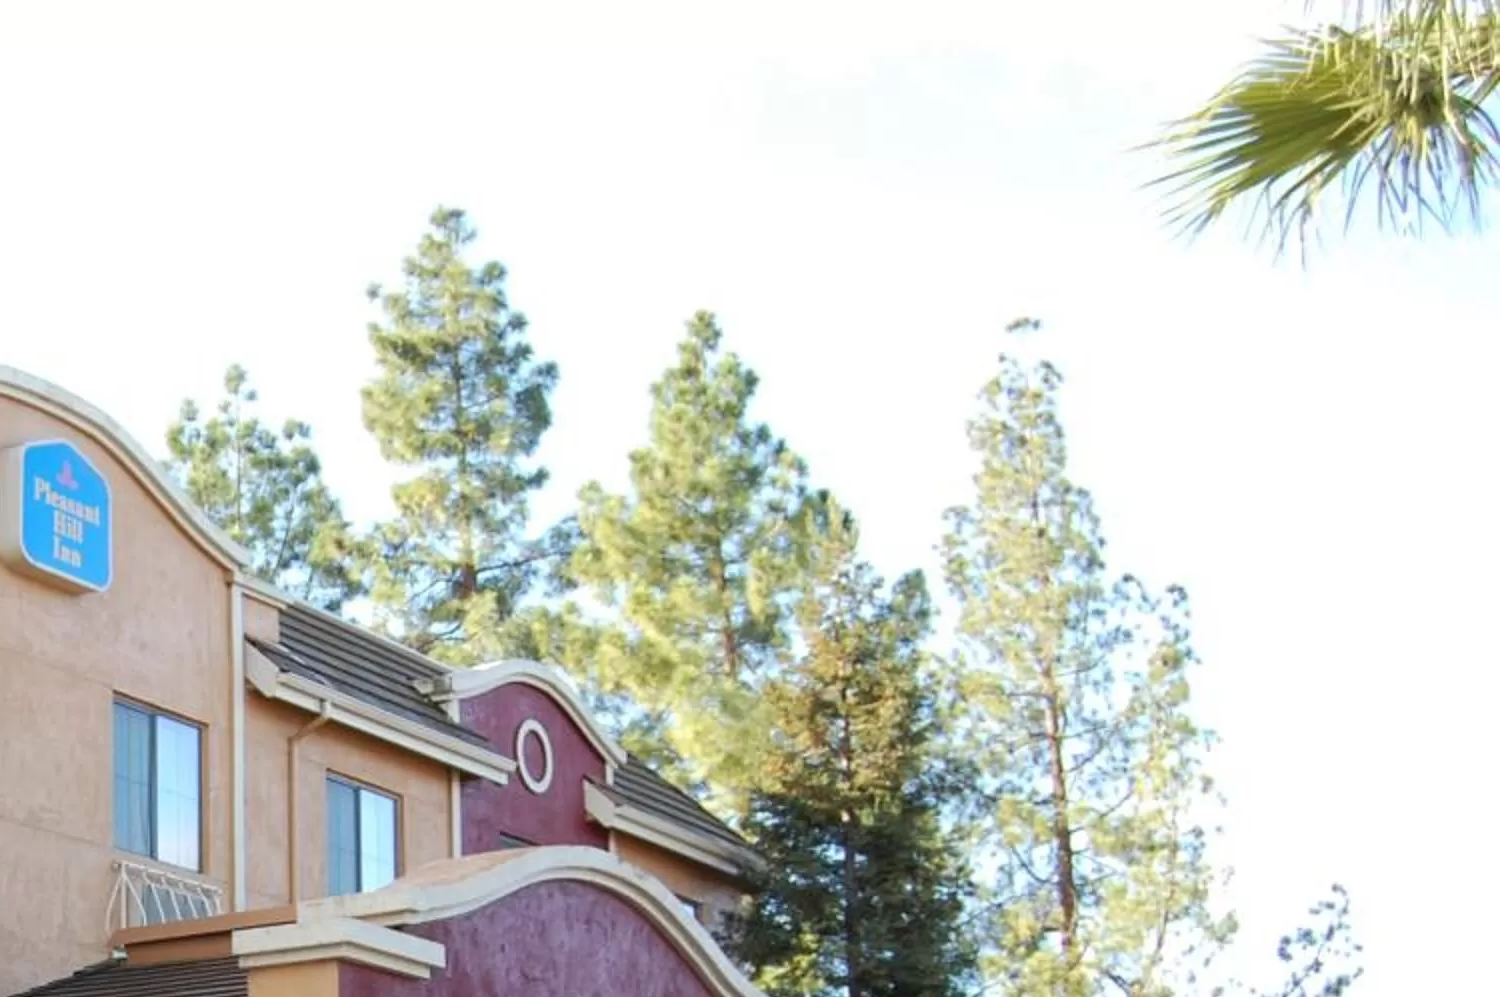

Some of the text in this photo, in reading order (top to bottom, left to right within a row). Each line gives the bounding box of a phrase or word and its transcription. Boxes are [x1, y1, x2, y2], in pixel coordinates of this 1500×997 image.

[34, 476, 100, 526] Pleasant
[53, 510, 84, 544] Hill
[53, 535, 82, 568] Inn
